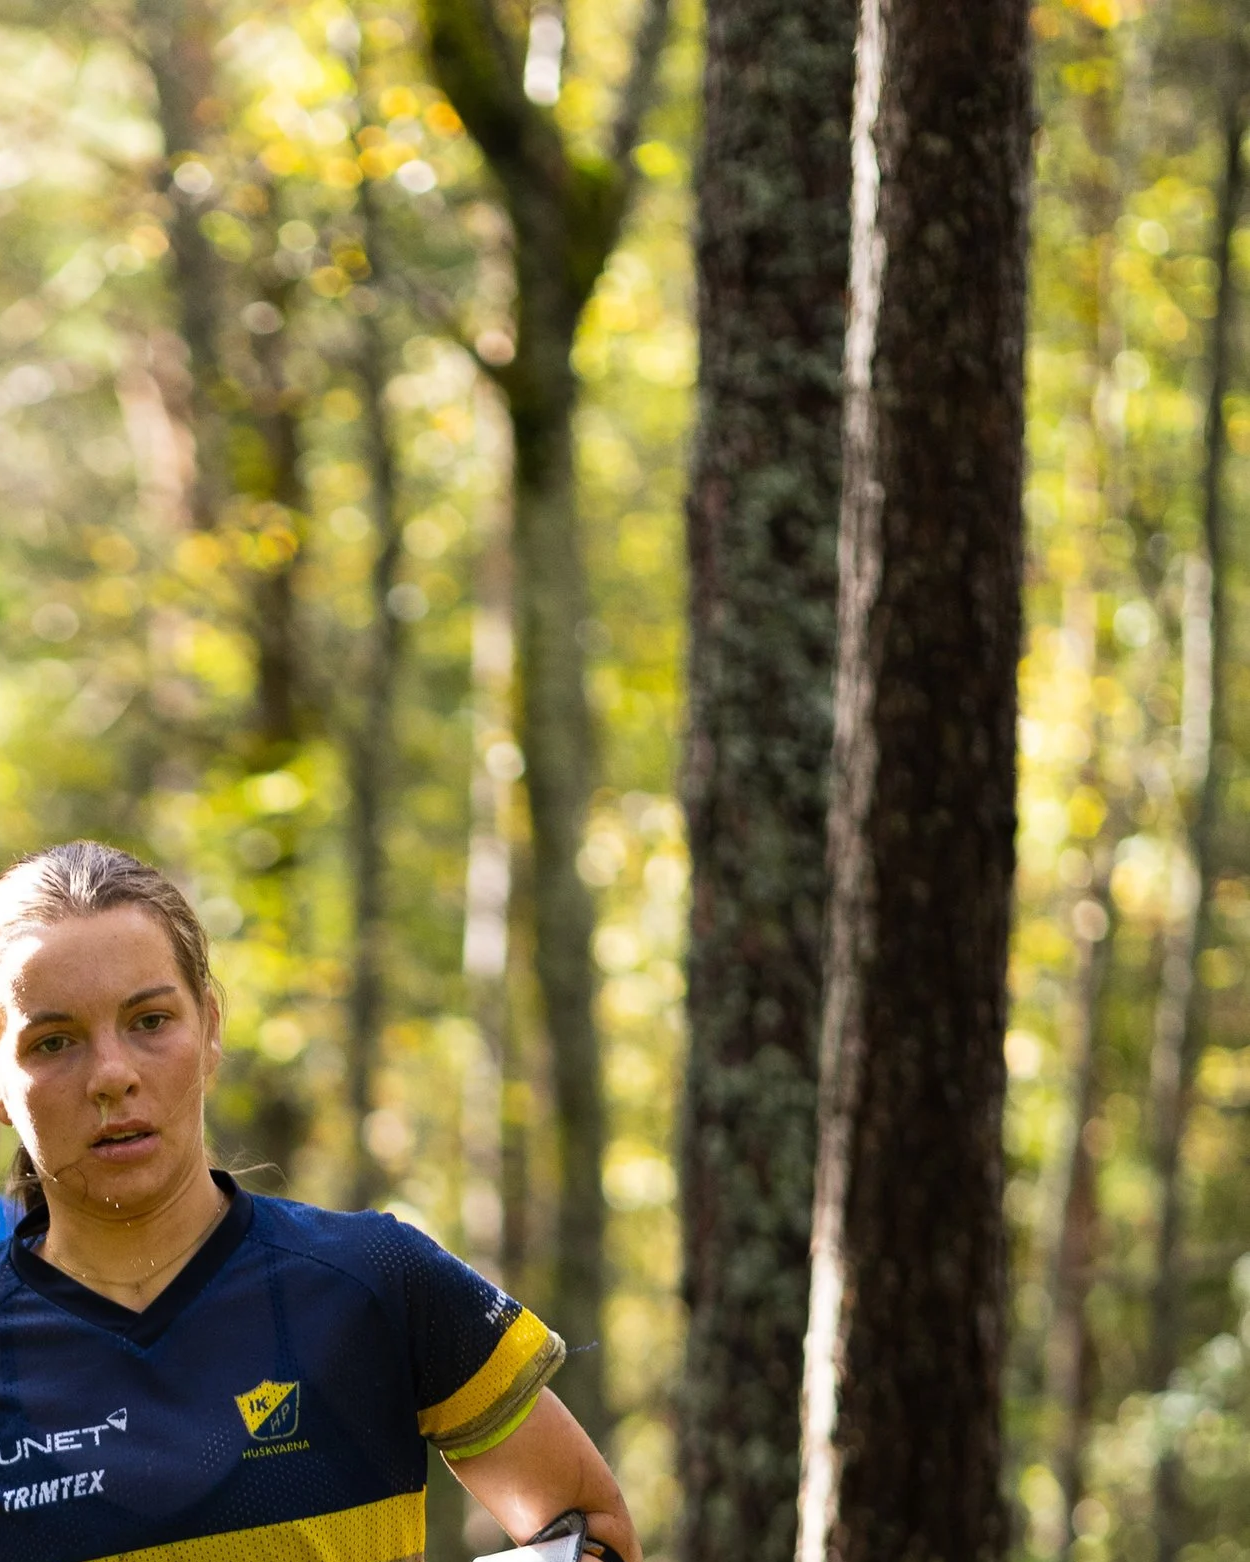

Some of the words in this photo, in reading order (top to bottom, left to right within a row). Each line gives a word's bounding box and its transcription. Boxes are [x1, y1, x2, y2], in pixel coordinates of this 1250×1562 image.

[249, 1395, 270, 1414] IK
[270, 1402, 291, 1433] HP
[242, 1439, 311, 1460] HUSKVARNA
[2, 1469, 105, 1512] TRIMTEX
